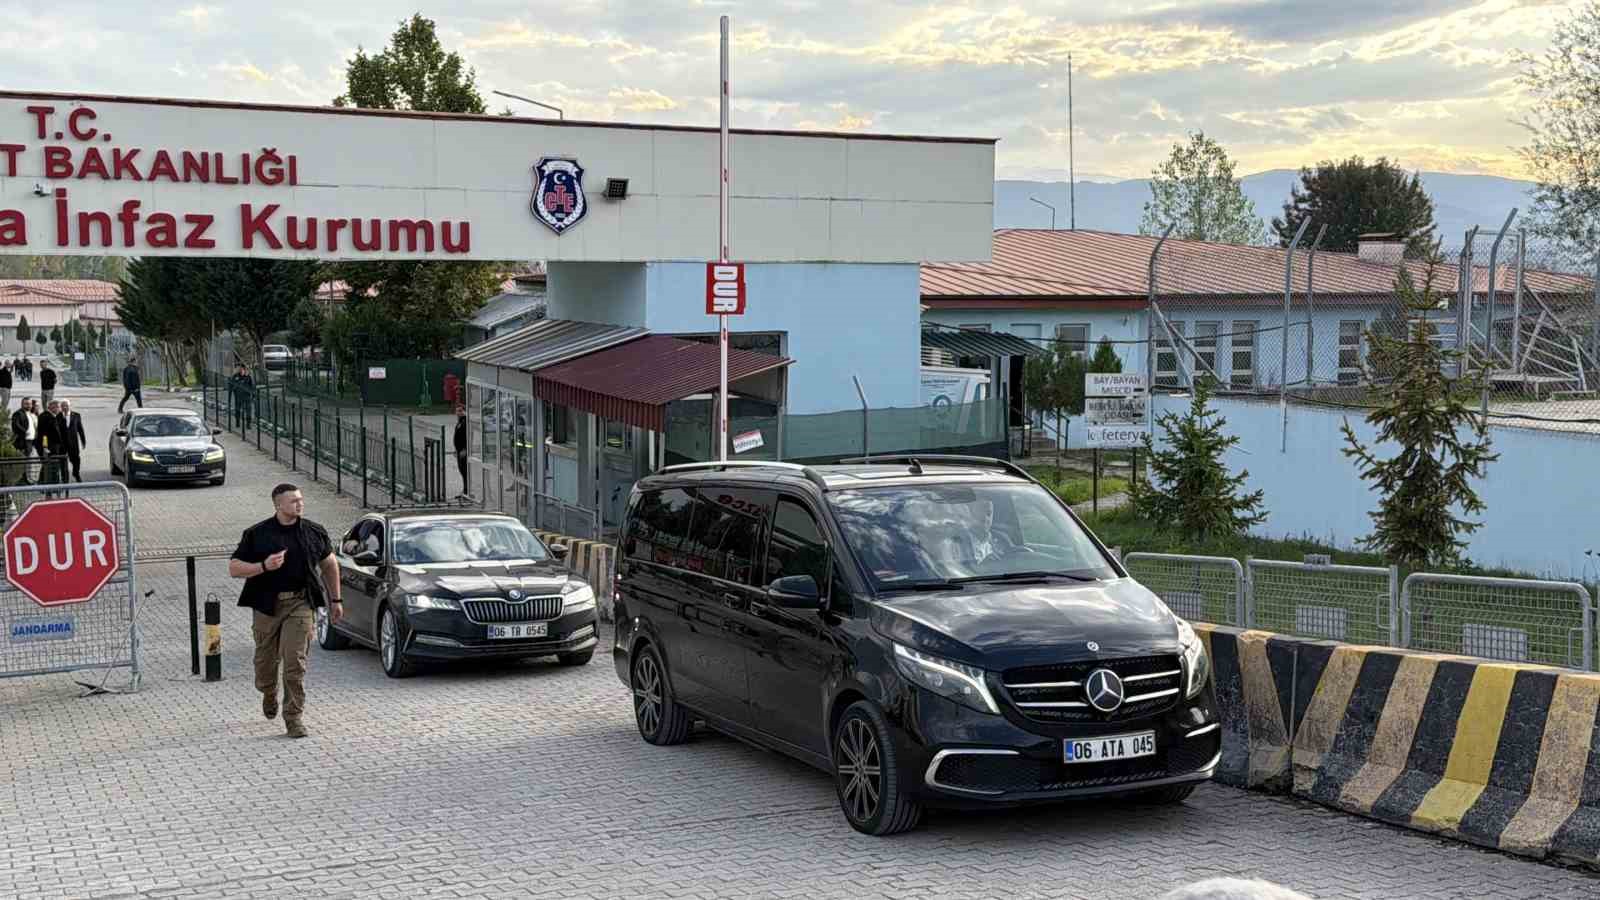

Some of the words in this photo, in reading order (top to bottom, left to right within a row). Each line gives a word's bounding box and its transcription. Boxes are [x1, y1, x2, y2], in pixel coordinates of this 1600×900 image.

[27, 106, 112, 142] T.C.
[44, 147, 298, 187] BAKANLIĞI
[55, 188, 216, 248] İnfaz
[240, 203, 471, 253] Kurumu
[713, 265, 738, 312] DUR
[1094, 376, 1140, 385] BAY/BAYAN
[1088, 429, 1146, 443] kfeterya
[14, 529, 109, 576] DUR
[12, 623, 72, 636] JANDARMA
[1074, 742, 1092, 759] 06
[1102, 740, 1125, 758] ATA
[1133, 736, 1153, 753] 045
